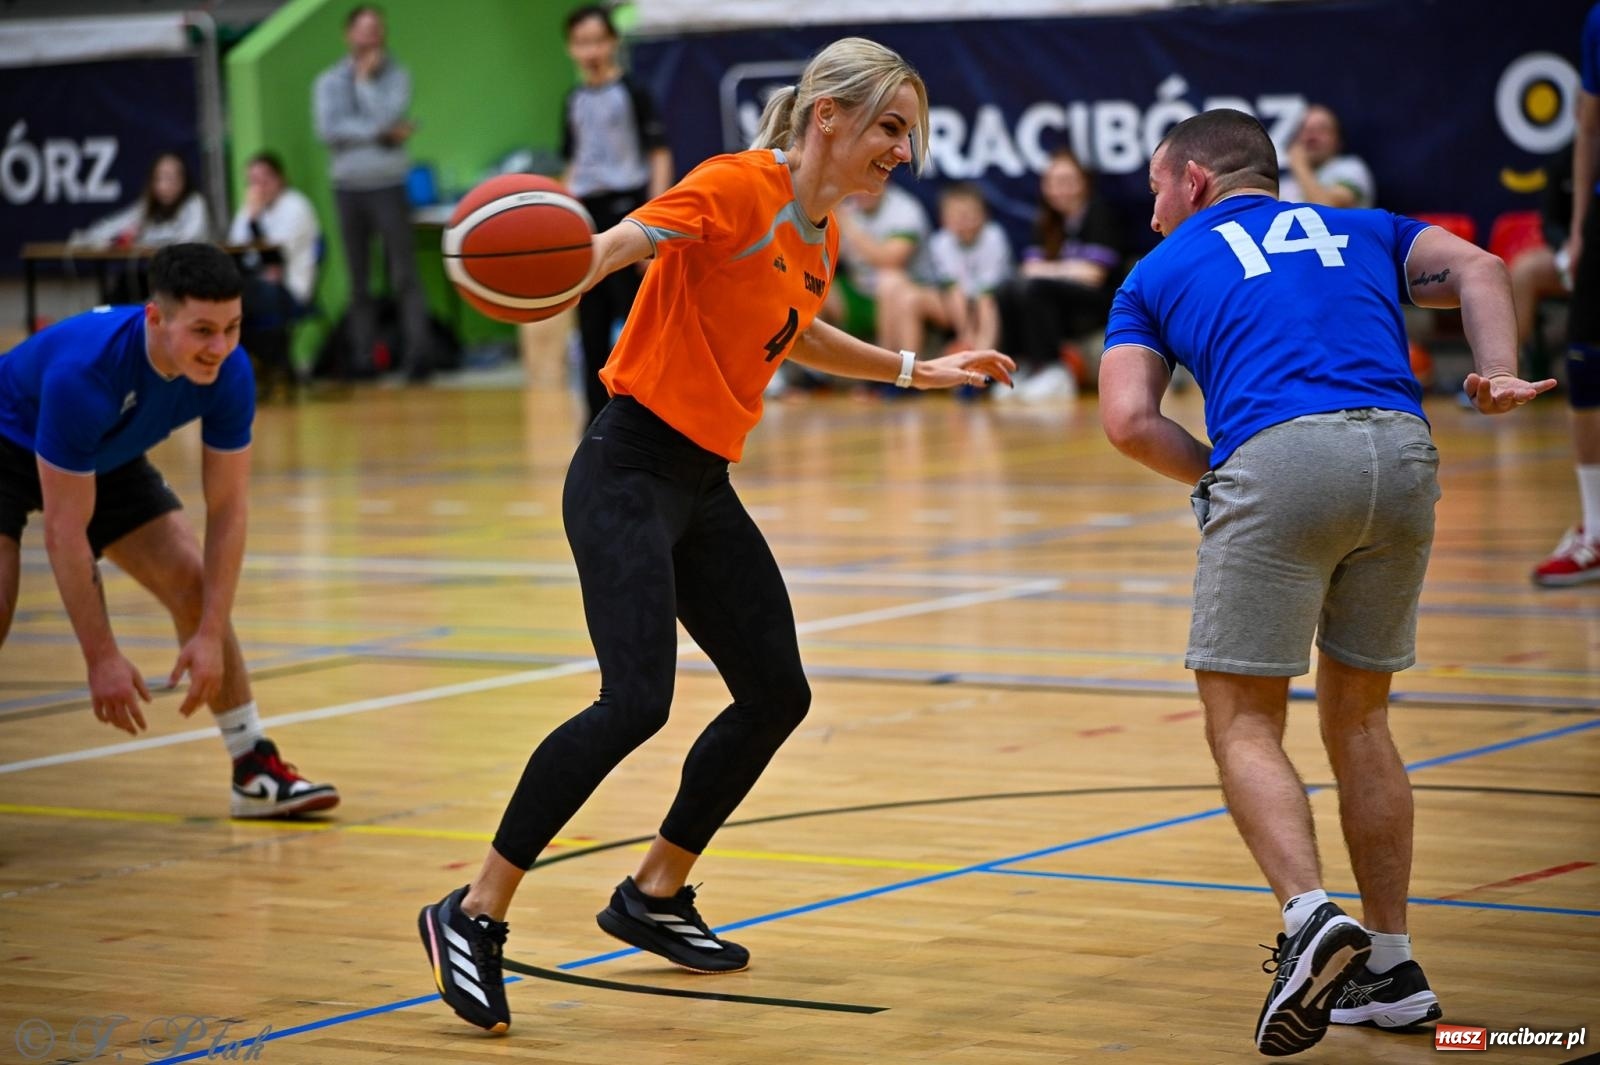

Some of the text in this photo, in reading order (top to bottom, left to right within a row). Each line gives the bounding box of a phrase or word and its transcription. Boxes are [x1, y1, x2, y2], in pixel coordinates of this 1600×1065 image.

[0, 119, 121, 204] ÓRZ
[922, 74, 1304, 178] RACIBÓZ
[1211, 206, 1349, 279] 14
[763, 306, 799, 362] 4
